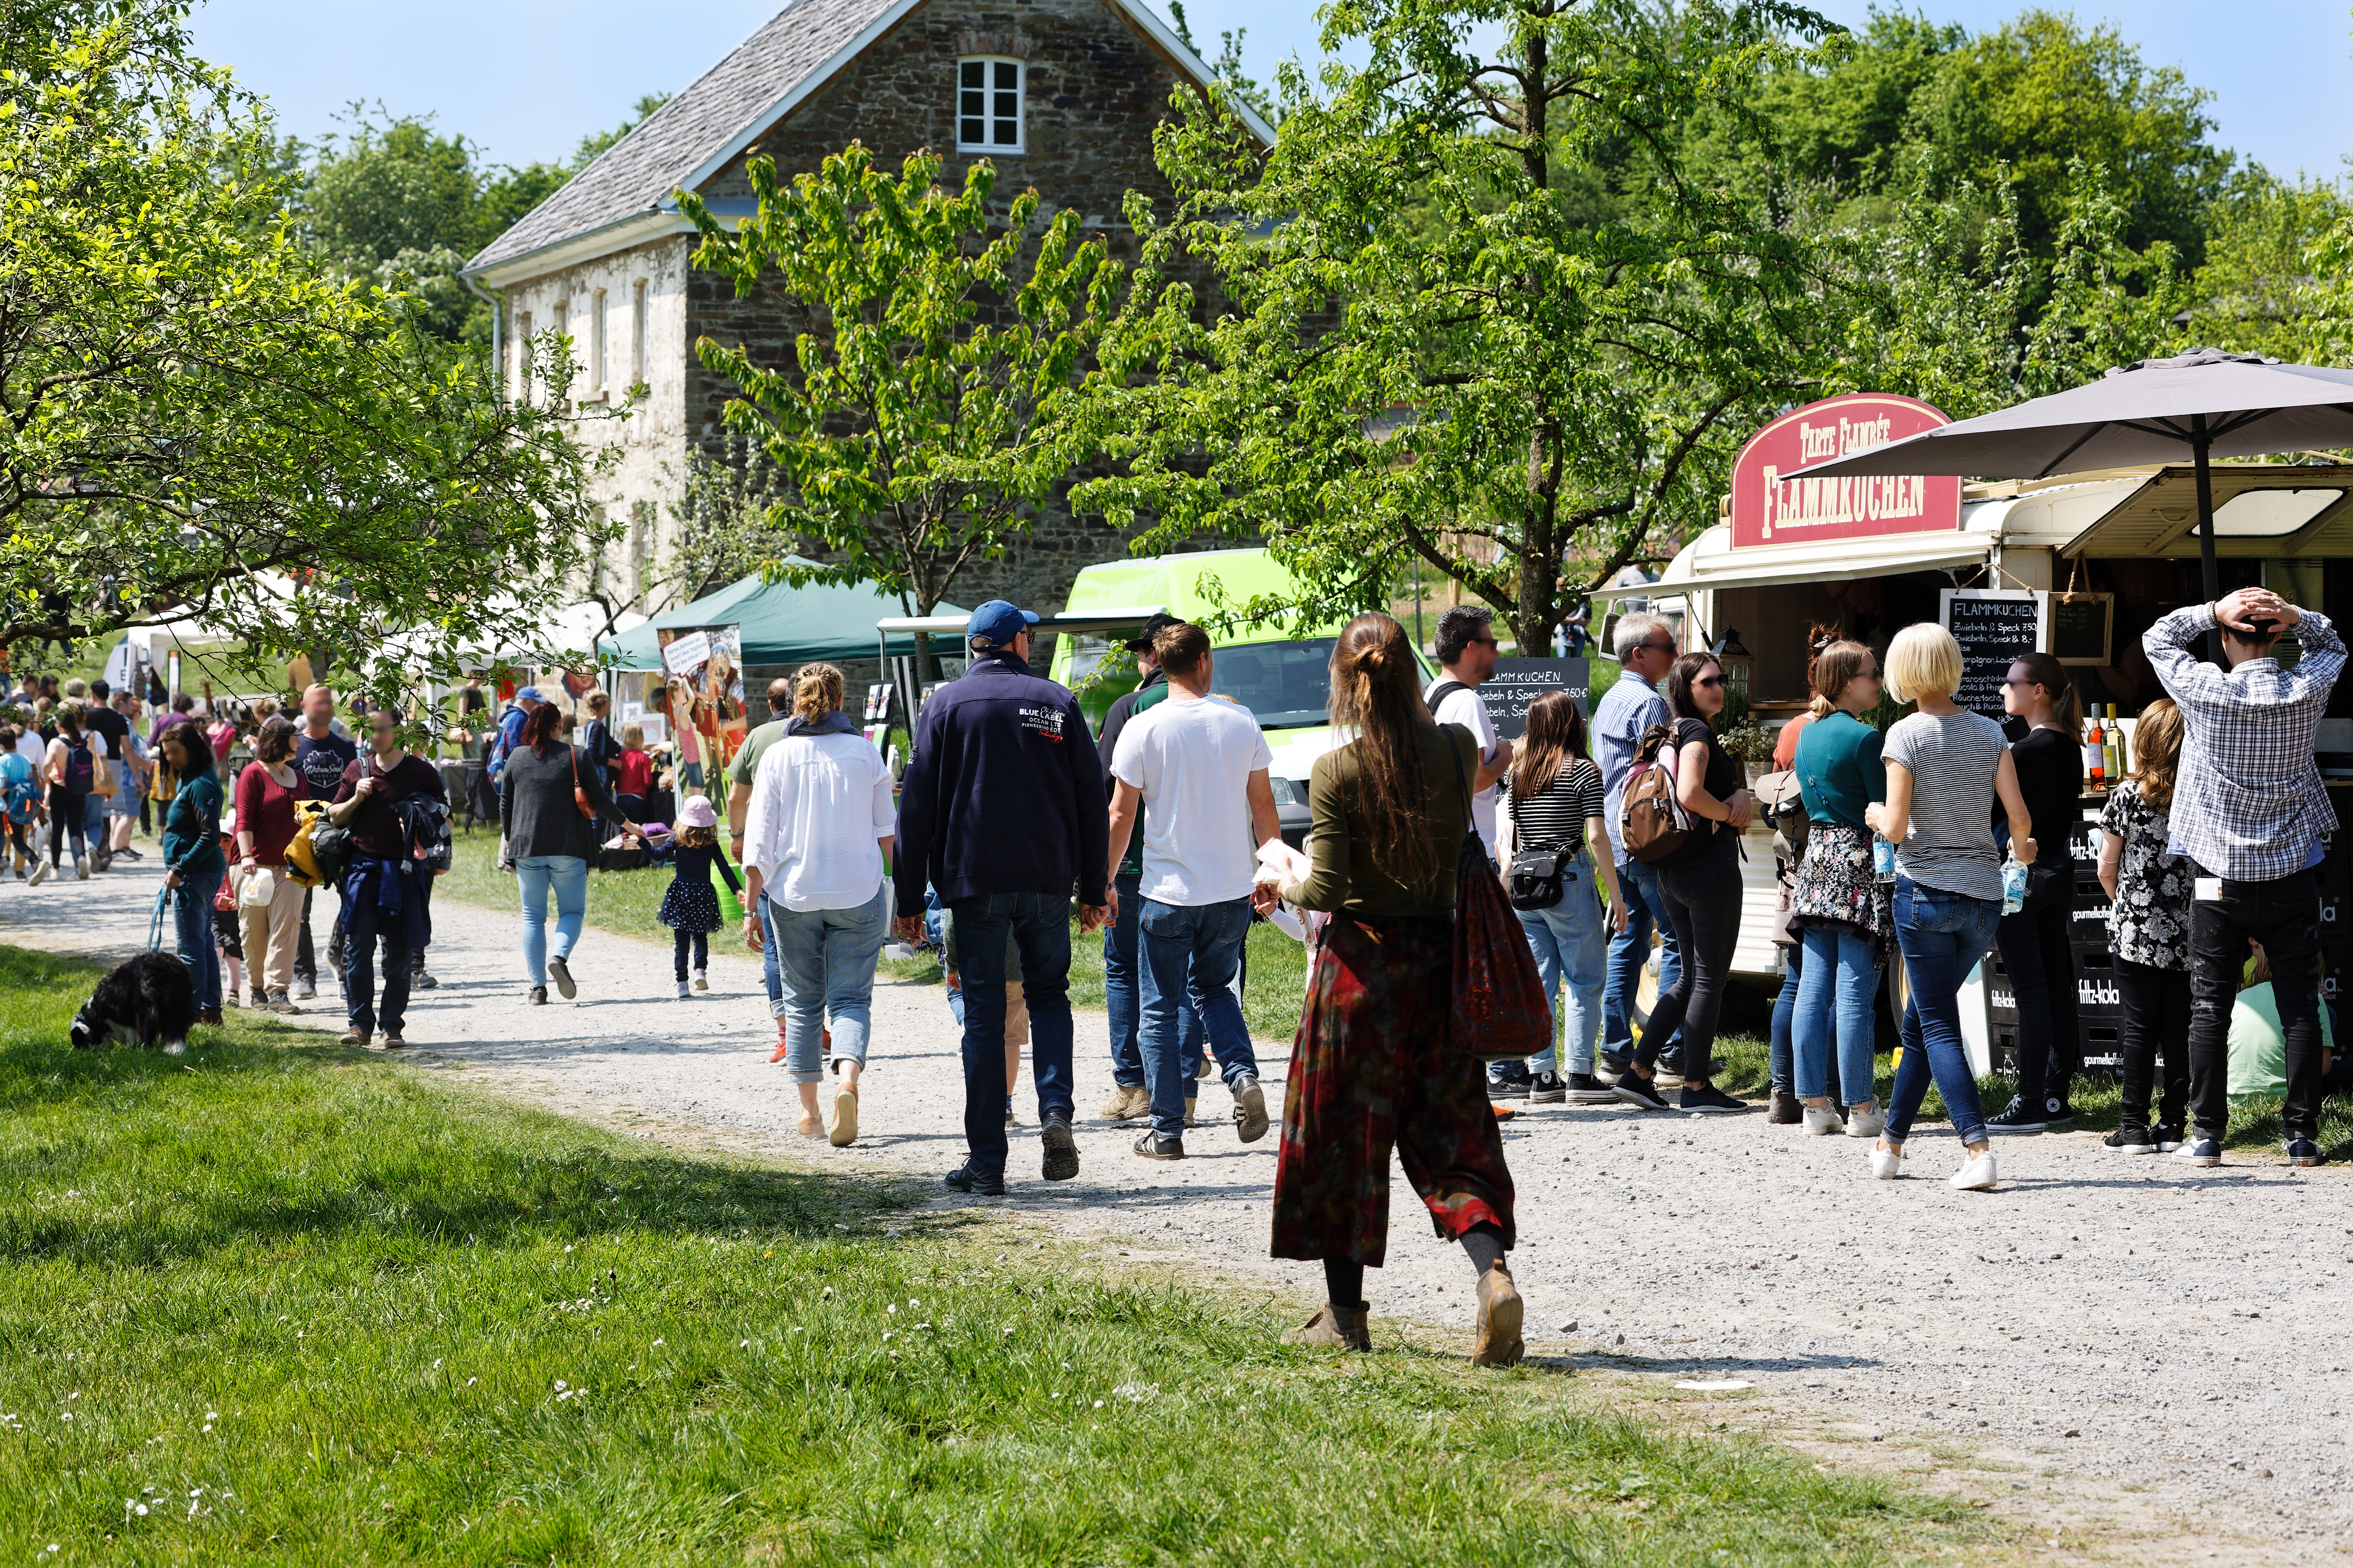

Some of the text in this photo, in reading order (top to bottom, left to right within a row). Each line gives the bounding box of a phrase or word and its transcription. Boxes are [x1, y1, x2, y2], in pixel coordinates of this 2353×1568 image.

[1800, 412, 1891, 464] TARTE FLAMBÉE
[1762, 465, 1925, 539] FLAMMKUCHEN
[1955, 603, 2037, 617] FLAMMKUCHEN
[1954, 622, 1987, 631] Zwiebeln
[1989, 623, 1995, 631] &
[1998, 623, 2020, 634] Speck
[1954, 634, 1988, 643] Zwiebeln,
[1989, 635, 2010, 644] Speck
[1963, 656, 1996, 667] ampignon,
[1489, 672, 1560, 682] AMMKUCHEN
[1473, 689, 1504, 701] iebeln
[1507, 690, 1514, 699] &
[1019, 708, 1064, 723] BLUE LABEL
[1486, 704, 1528, 719] ebeln, Spe
[1997, 714, 2013, 725] étit
[2070, 837, 2098, 860] fritz-ko
[2078, 979, 2119, 1004] fritz-kola
[1992, 990, 2016, 1008] fritz-kola
